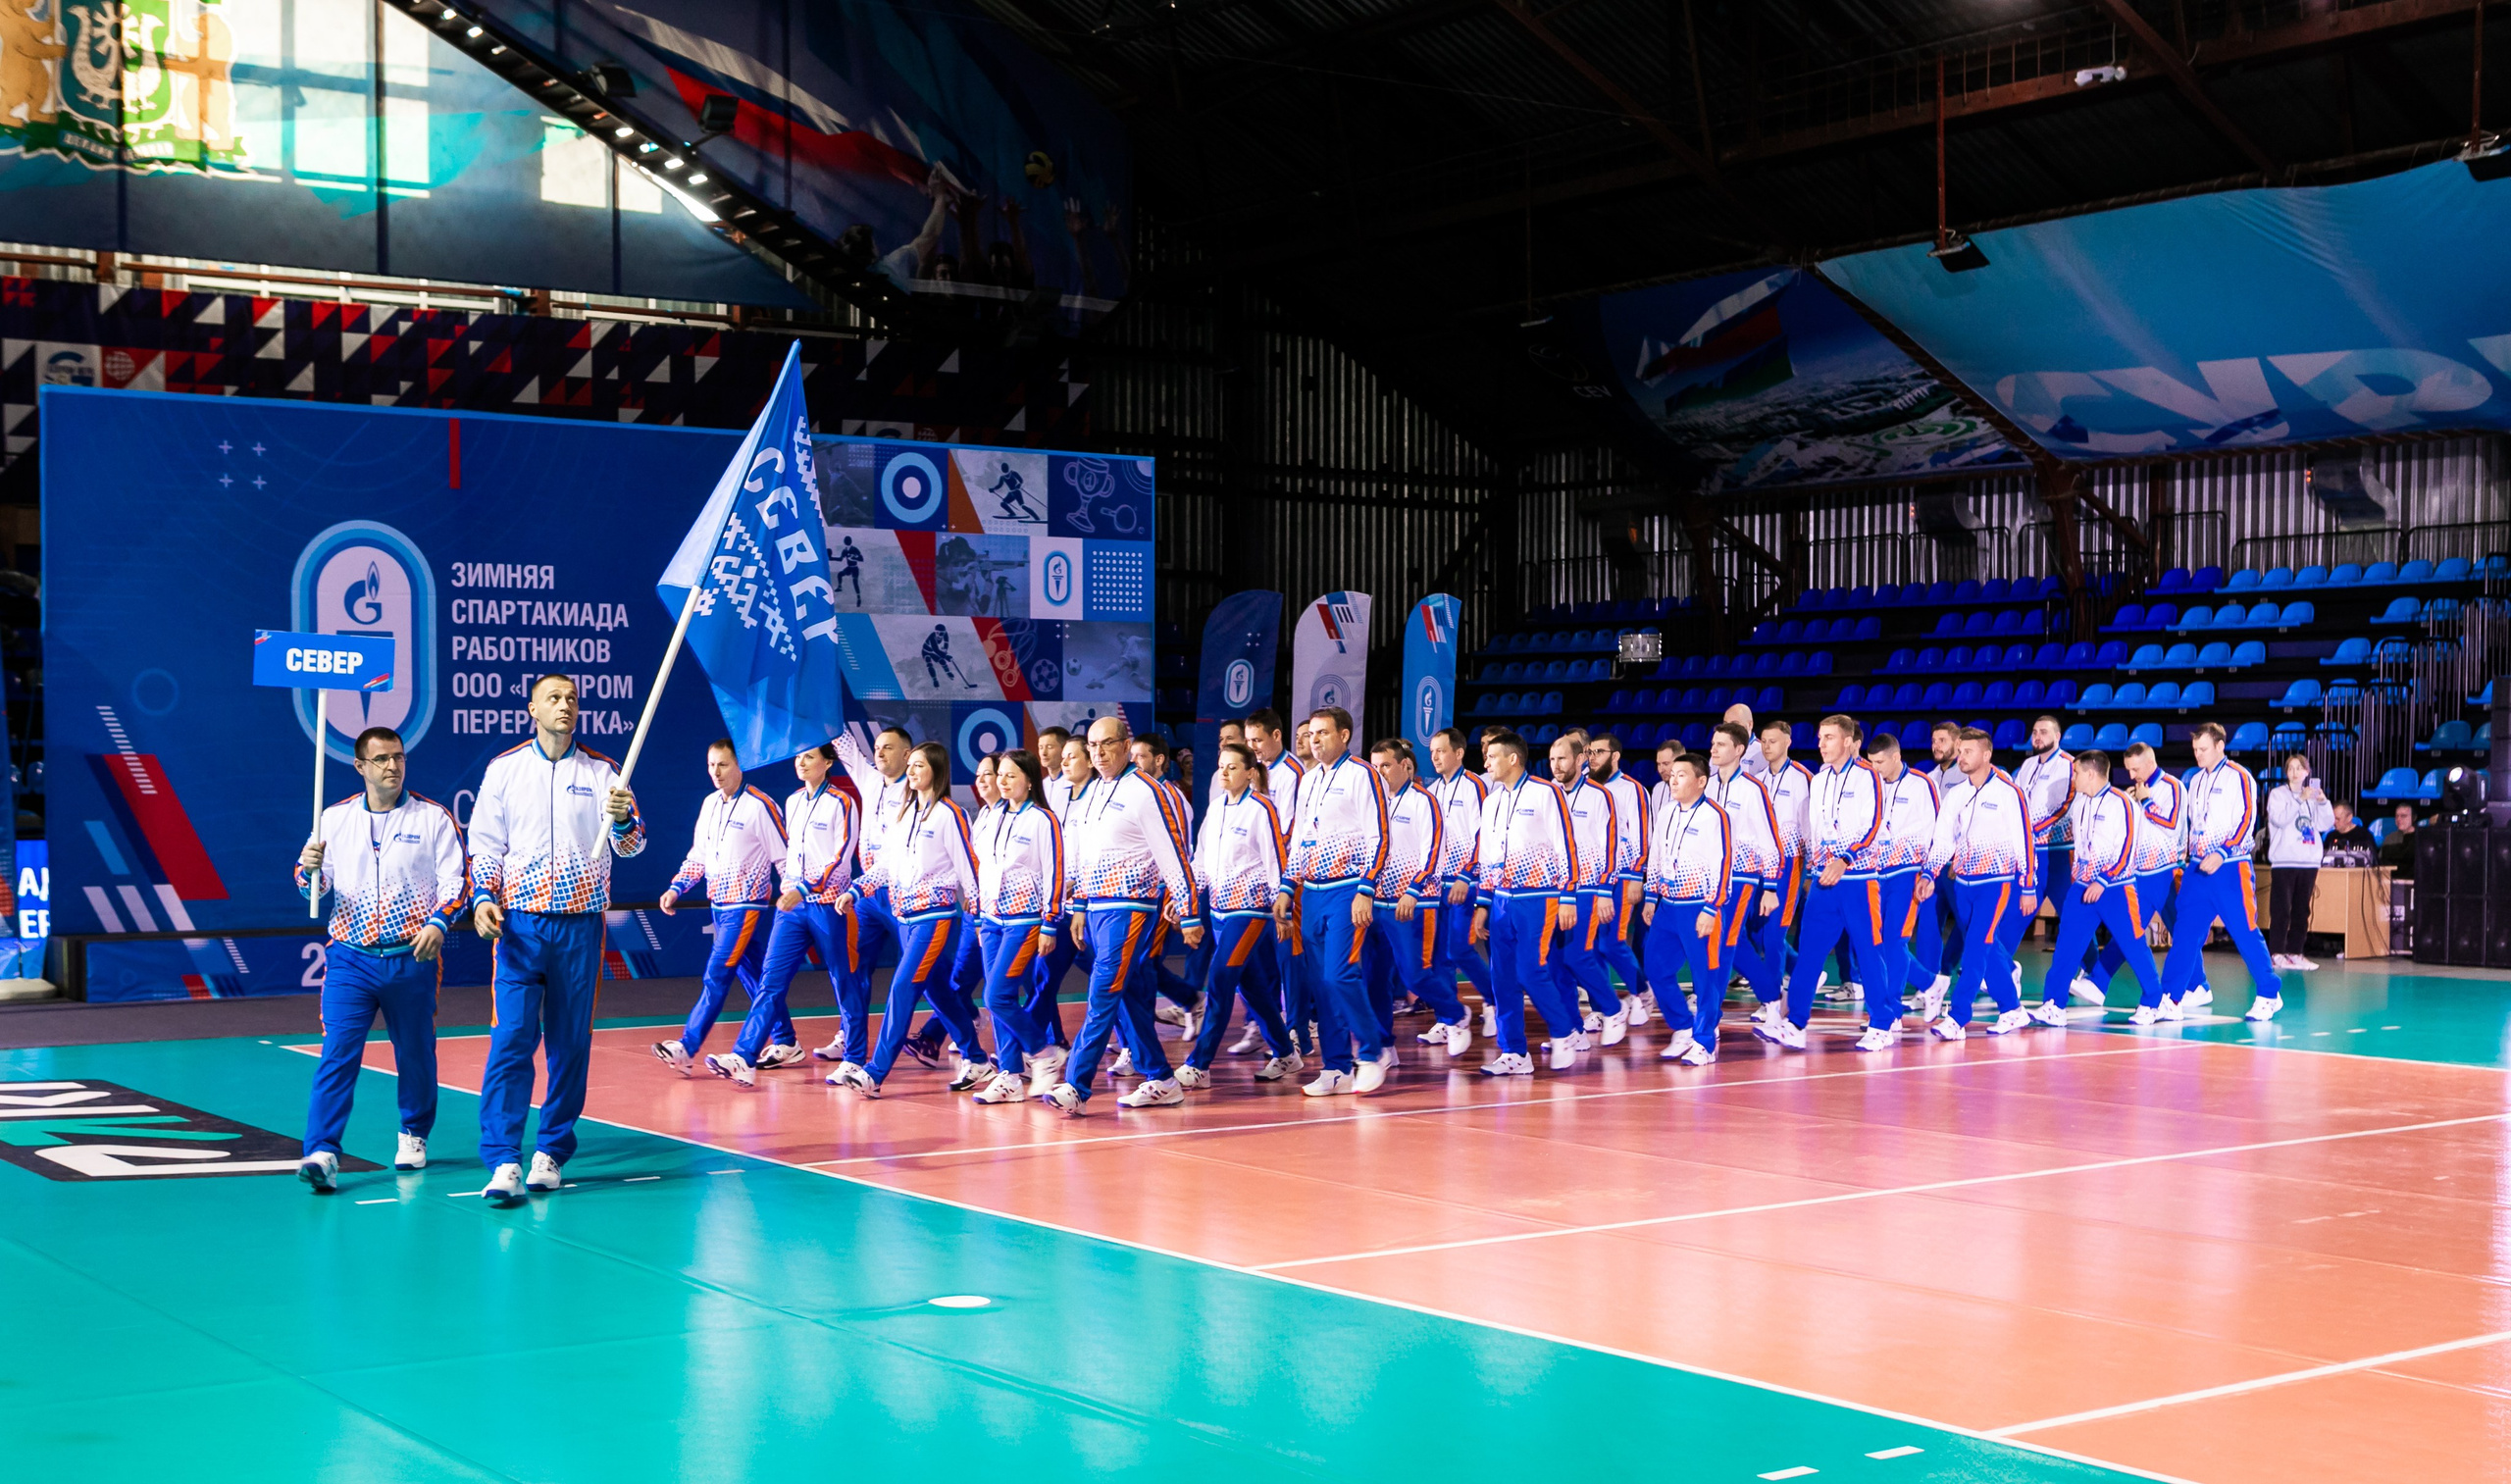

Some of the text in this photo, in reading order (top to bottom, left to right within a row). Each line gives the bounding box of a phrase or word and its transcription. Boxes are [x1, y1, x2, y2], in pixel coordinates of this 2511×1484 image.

[1996, 332, 2511, 453] СУР
[450, 561, 555, 589] ЗИМНЯЯ
[451, 598, 630, 631] СПАРТАКИАДА
[285, 647, 364, 675] СЕВЕР
[451, 636, 611, 663] РАБОТНИКОВ
[452, 672, 634, 699] ООО «ГПРОМ
